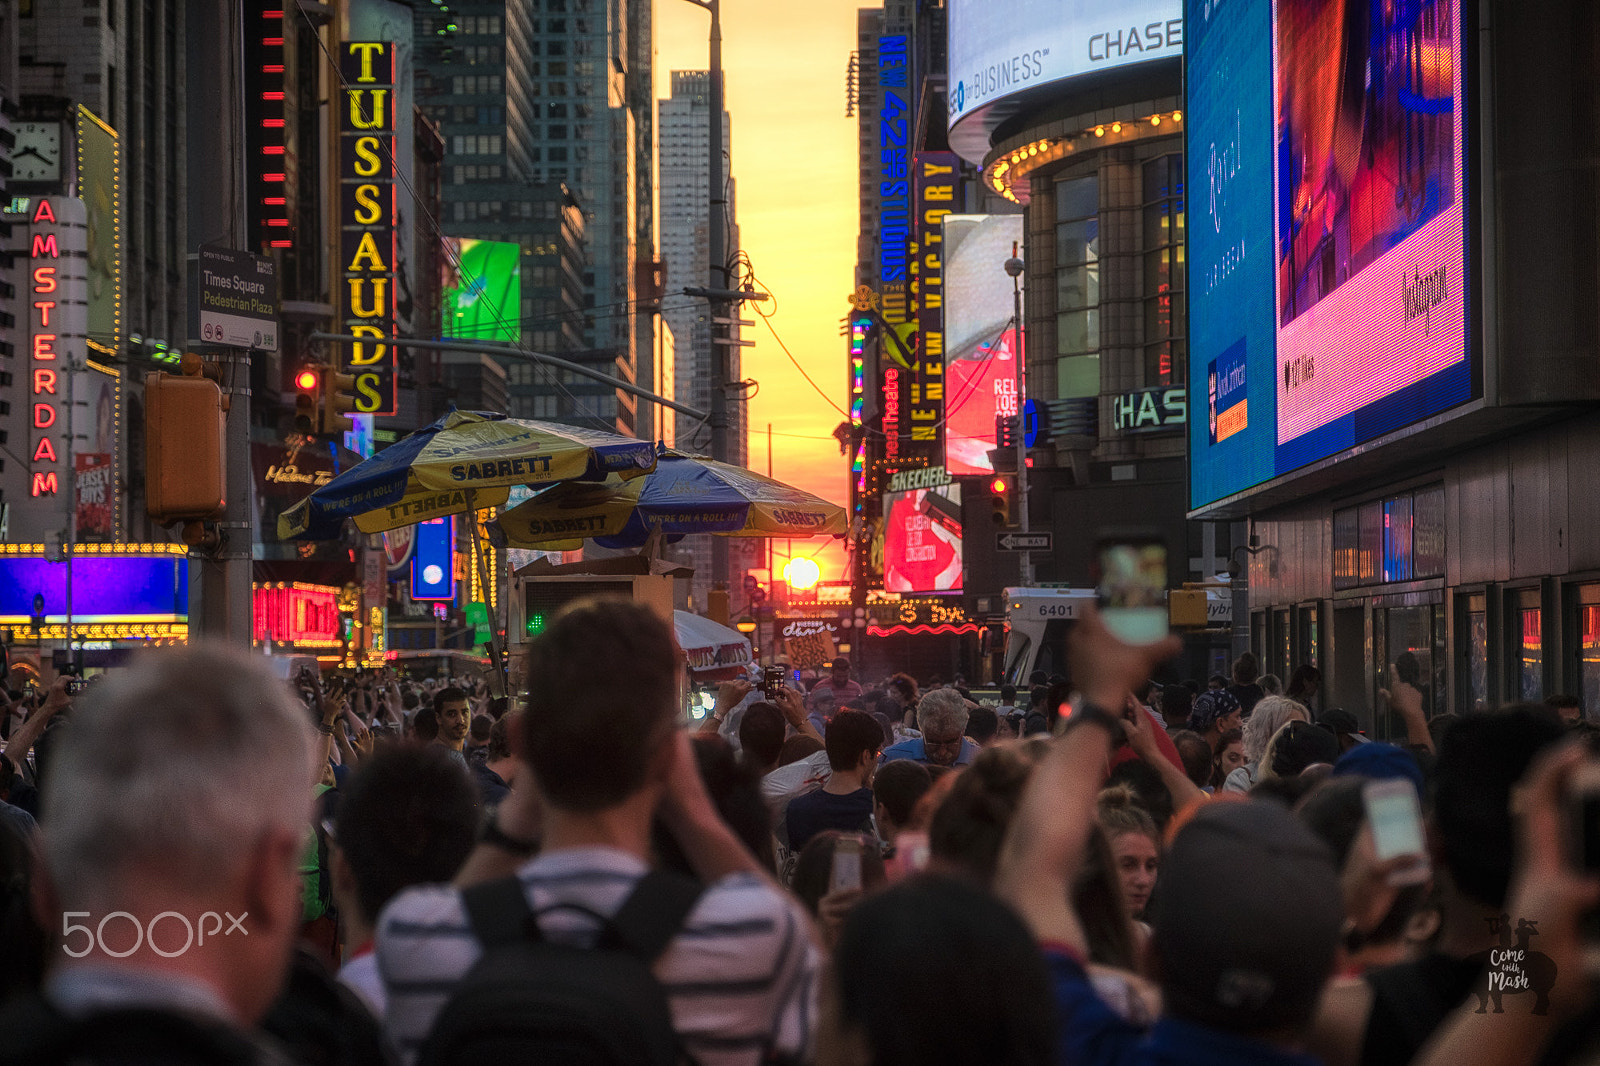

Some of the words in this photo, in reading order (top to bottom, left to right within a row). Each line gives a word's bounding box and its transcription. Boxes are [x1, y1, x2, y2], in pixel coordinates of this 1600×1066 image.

[1088, 18, 1182, 62] CHASE
[879, 35, 907, 87] NEW
[974, 50, 1042, 99] BUSINESS
[347, 42, 386, 413] TUSSAUDS
[203, 270, 232, 289] Times
[233, 275, 265, 294] Square
[204, 291, 250, 311] Pedestrian
[251, 299, 273, 315] Plaza
[32, 199, 58, 497] AMSTERDAM
[994, 379, 1018, 395] REL
[451, 455, 553, 482] SABRETT
[322, 498, 350, 512] WE'RE
[352, 492, 365, 504] ON
[366, 490, 372, 499] A
[373, 486, 393, 498] ROLL
[529, 515, 607, 535] SABRETT
[649, 514, 677, 523] WE'RE
[678, 513, 692, 522] ON
[693, 514, 701, 522] A
[702, 513, 725, 522] ROLL
[772, 509, 827, 526] SABRETT
[1005, 538, 1020, 546] ONE
[1028, 537, 1044, 546] WAY
[1039, 605, 1073, 616] 6401
